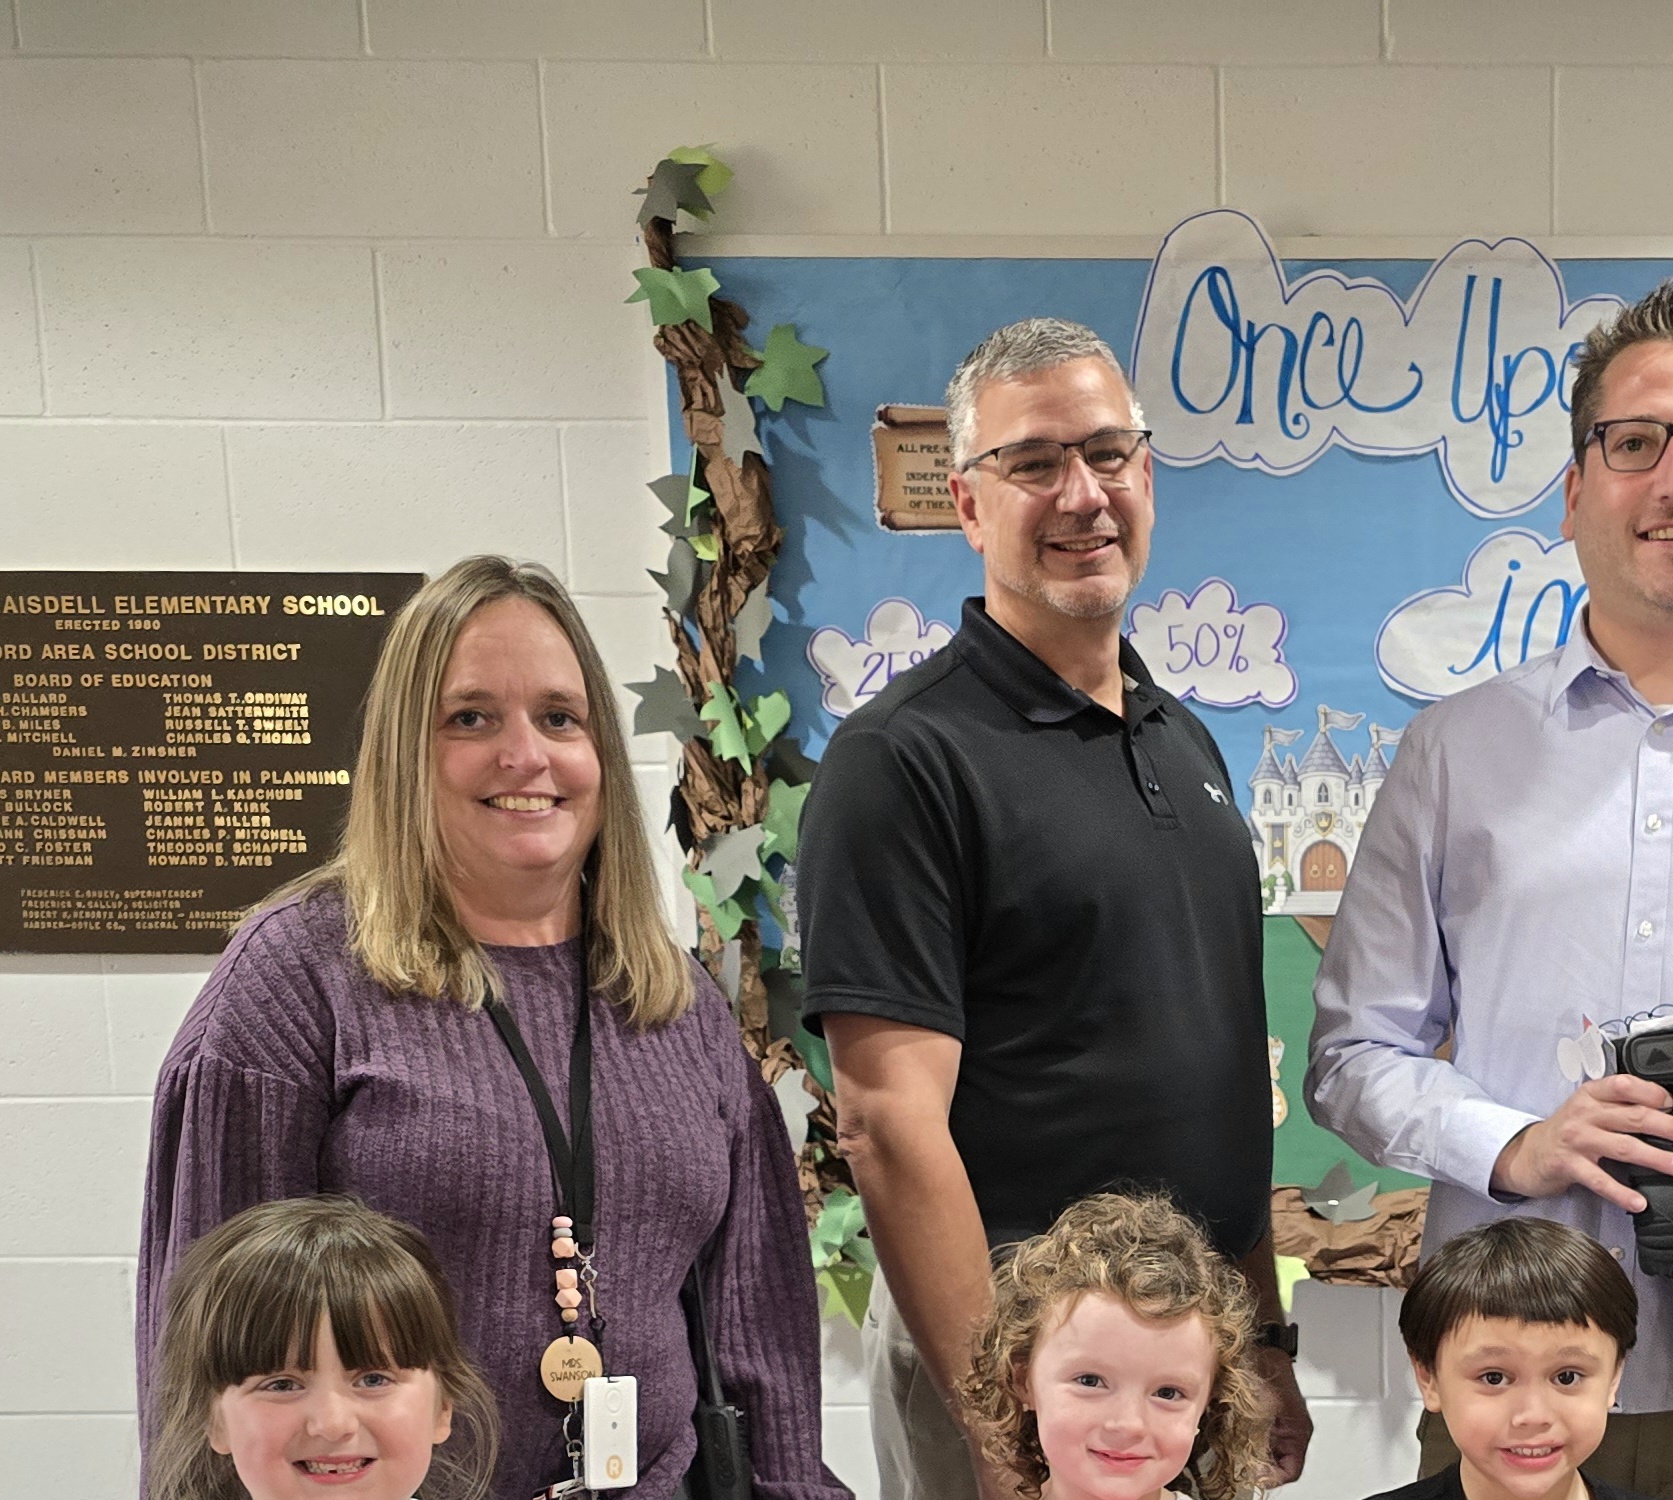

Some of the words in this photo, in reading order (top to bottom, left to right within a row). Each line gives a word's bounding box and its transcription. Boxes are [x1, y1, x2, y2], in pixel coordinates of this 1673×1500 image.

[1170, 265, 1423, 440] Once
[1451, 274, 1587, 483] Upo
[115, 595, 271, 615] ELEMENTARY
[283, 595, 385, 617] SCHOOL
[55, 620, 121, 631] ERECTED
[127, 620, 161, 631] 1980
[0, 644, 32, 660] RD
[41, 644, 95, 660] AREA
[105, 644, 192, 660] SCHOOL
[203, 643, 301, 660] DISTRICT
[1166, 624, 1249, 673] 50%
[14, 674, 73, 687] BOARD
[80, 674, 104, 687] OF
[111, 674, 213, 688] EDUCATION
[2, 693, 67, 703] BALLARD
[163, 693, 222, 704] THOMAS
[11, 706, 88, 717] CHAMBERS
[165, 706, 201, 717] JEAN
[208, 706, 309, 718] SATTERWHITE
[19, 720, 61, 730] MILES
[165, 719, 232, 730] RUSSELL
[7, 733, 77, 743] MITCHELL
[166, 733, 232, 744] CHARLES
[252, 732, 311, 744] THOMAS
[53, 746, 105, 757] DANIEL
[44, 771, 129, 783] MEMBERS
[138, 770, 224, 784] INVOLVED
[233, 771, 251, 784] IN
[260, 770, 350, 784] PLANNING
[143, 789, 203, 800] WILLIAM
[5, 801, 73, 812] BULLOCK
[144, 802, 205, 813] ROBERT
[234, 802, 270, 813] KIRK
[30, 815, 106, 826] CALDWELL
[214, 815, 271, 827] MILLER
[33, 829, 107, 839] CRISSMAN
[145, 829, 211, 840] CHARLES
[235, 829, 306, 840] MITCHELL
[35, 842, 92, 852] FOSTER
[146, 842, 223, 853] THEODORE
[233, 842, 307, 853] SCHAFFER
[22, 855, 93, 866] FRIEDMAN
[148, 855, 208, 866] HOWARD
[231, 855, 273, 867] YATES
